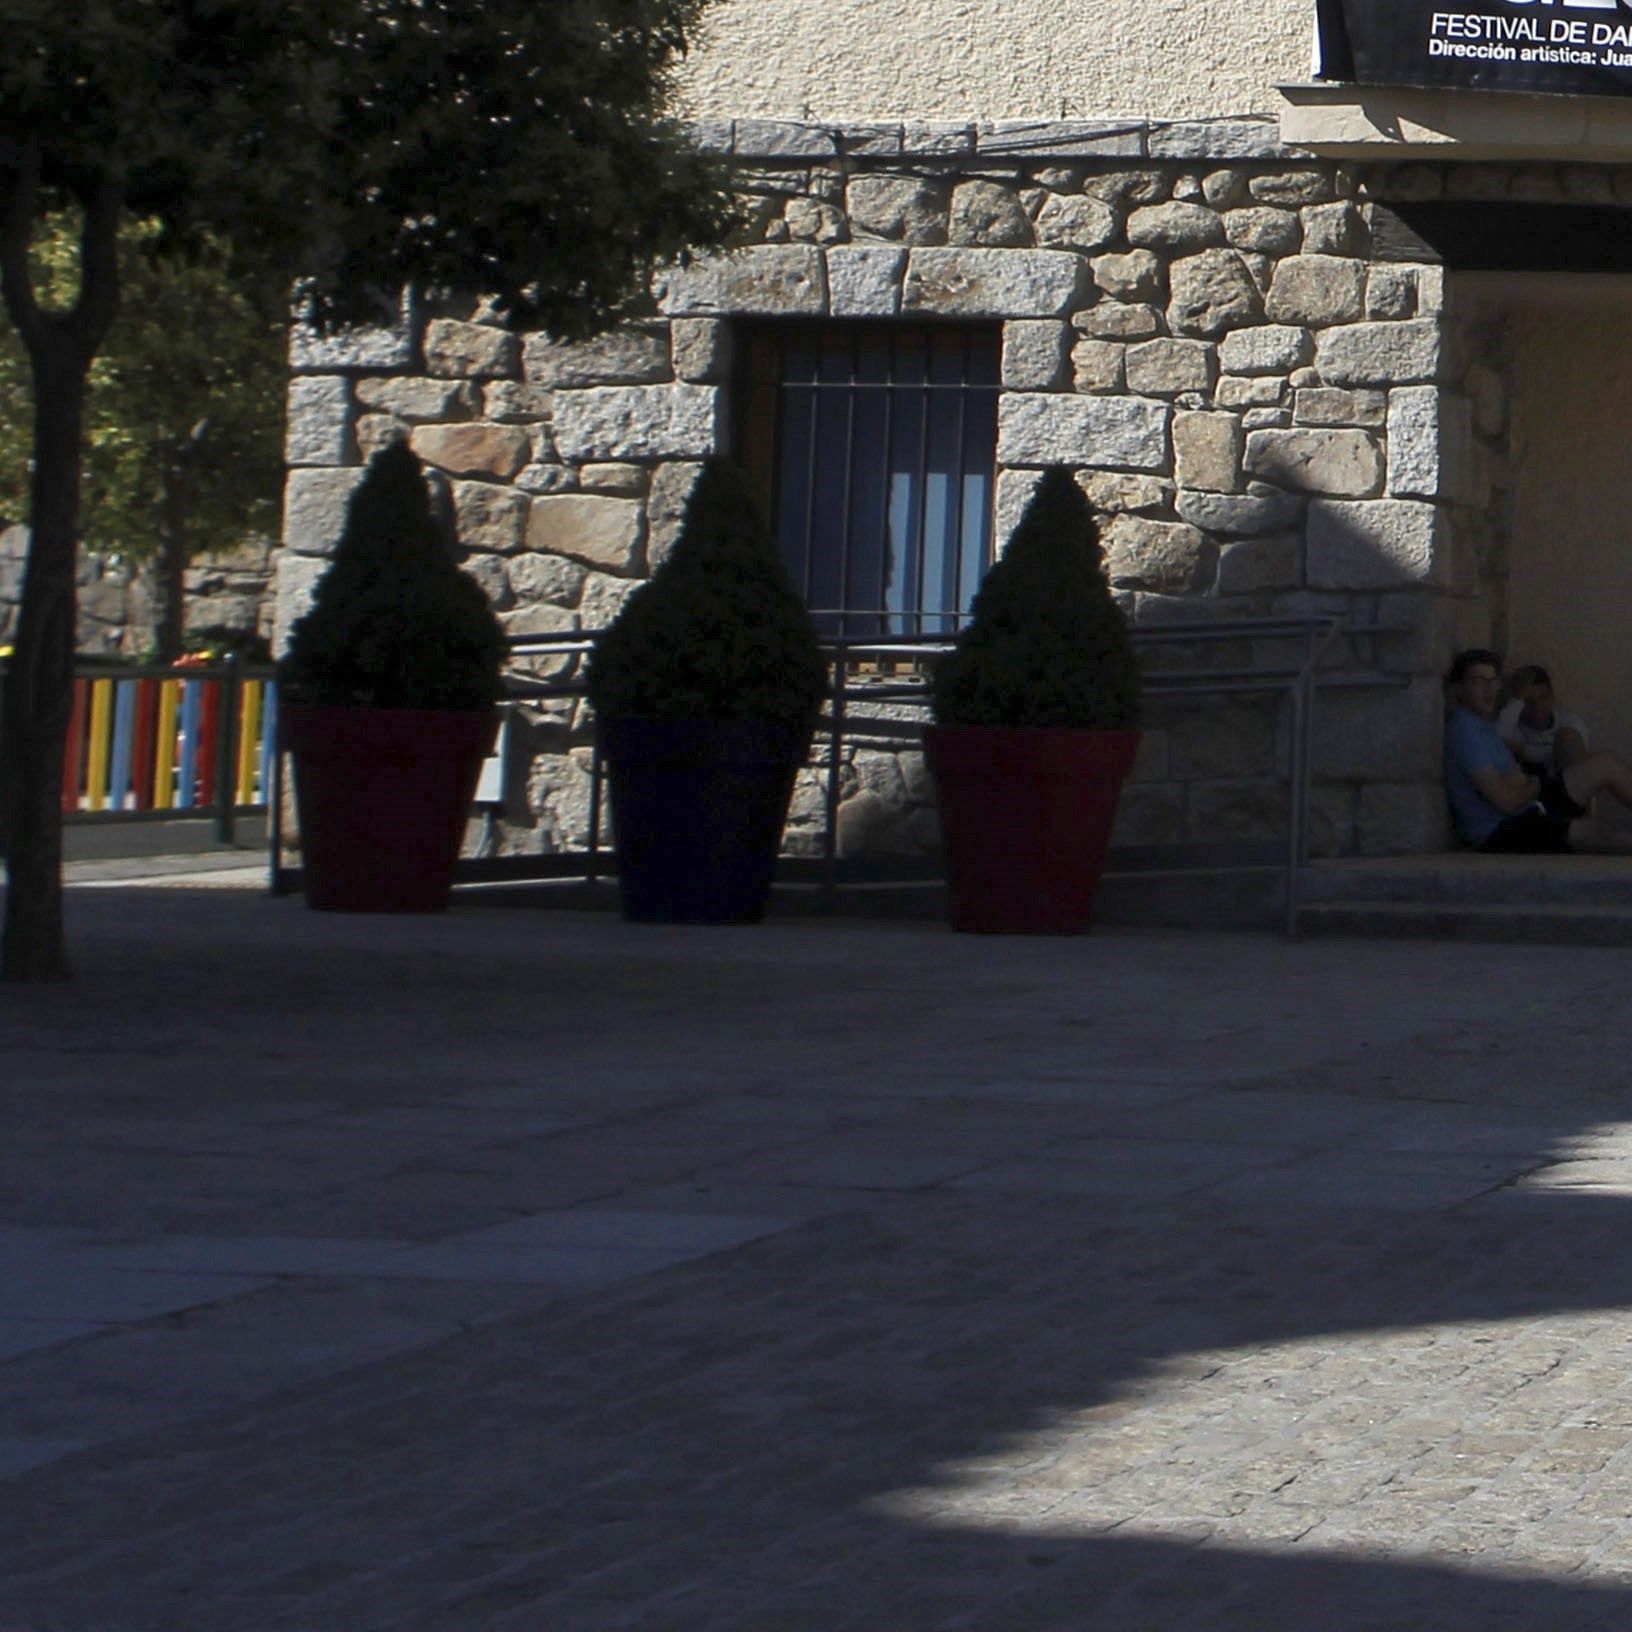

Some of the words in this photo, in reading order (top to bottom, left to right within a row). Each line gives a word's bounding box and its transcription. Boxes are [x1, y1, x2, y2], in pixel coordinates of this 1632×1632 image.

[1430, 12, 1546, 41] FESTIVAL
[1550, 19, 1587, 44] DE
[1429, 39, 1516, 61] Dirección
[1520, 45, 1597, 65] artística:
